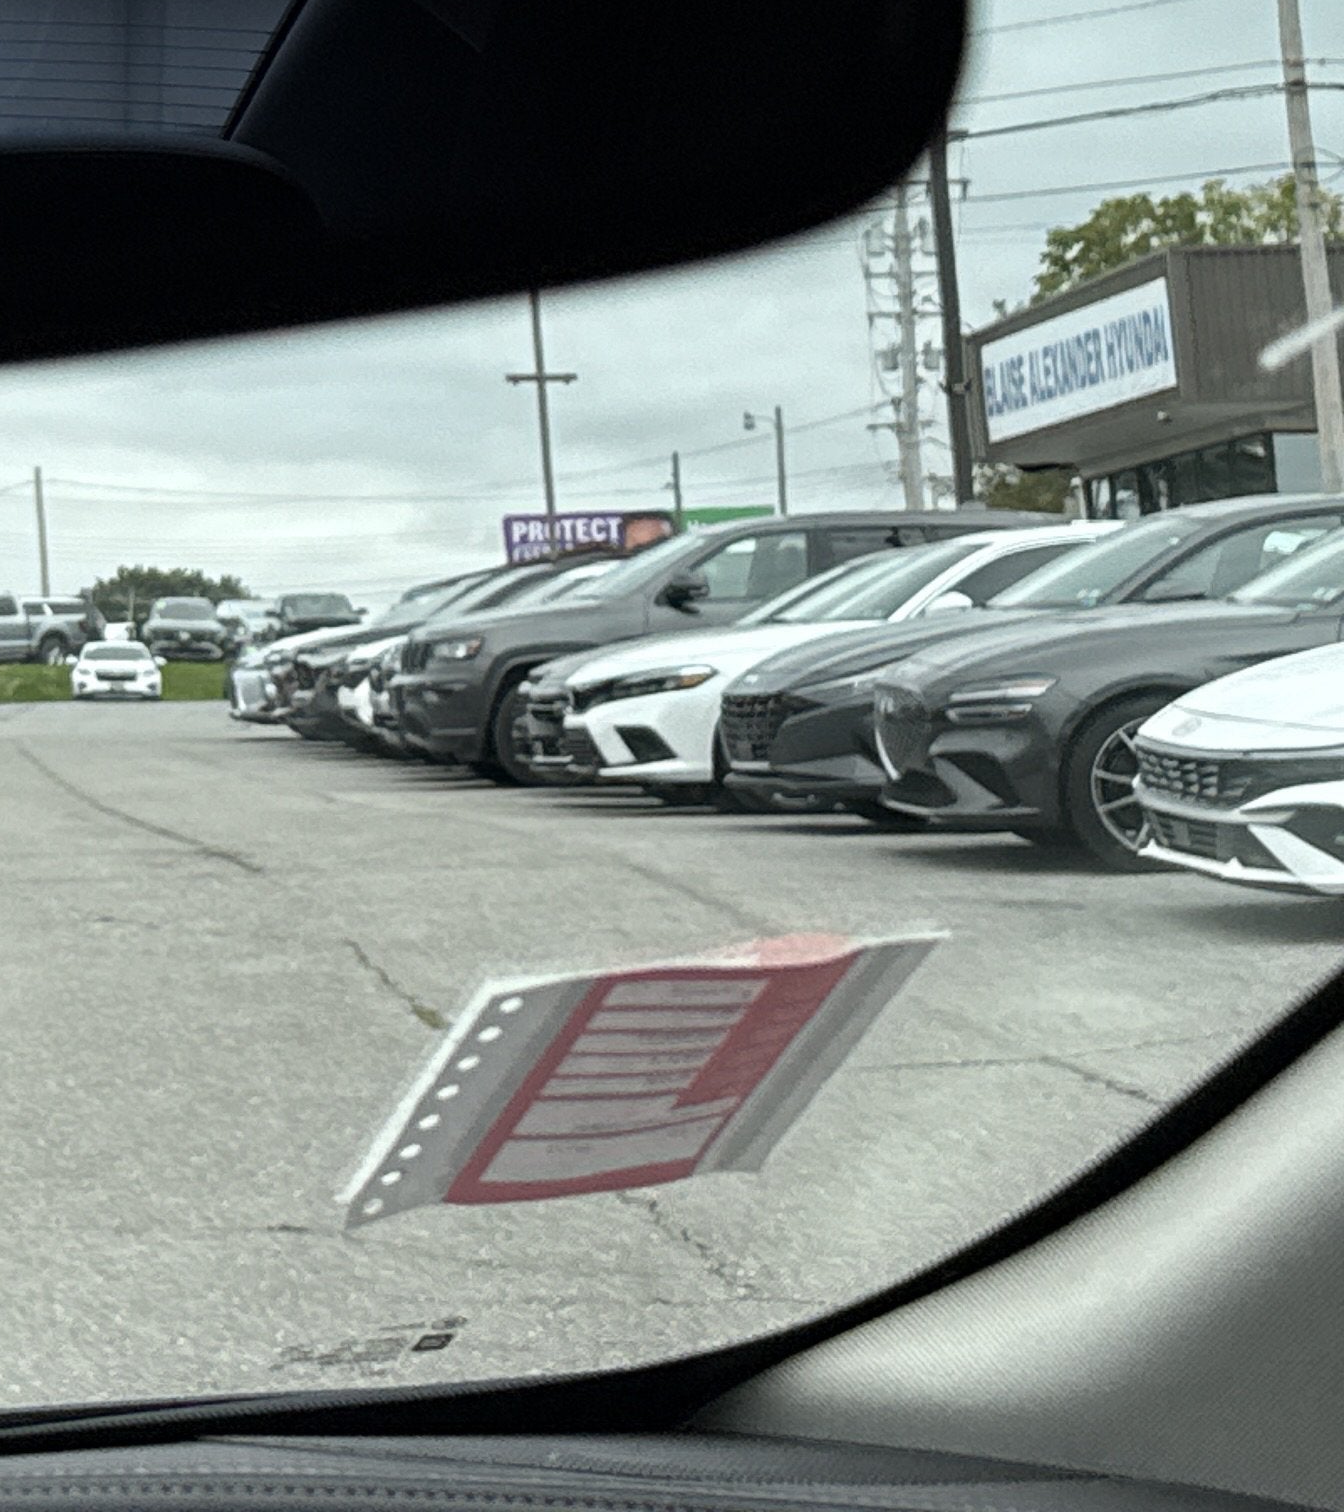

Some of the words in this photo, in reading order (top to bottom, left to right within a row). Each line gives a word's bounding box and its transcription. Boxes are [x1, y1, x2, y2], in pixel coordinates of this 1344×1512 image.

[1029, 328, 1105, 406] ALEXANDER
[1104, 304, 1169, 378] HYUNDAI
[512, 517, 623, 544] PROTECT
